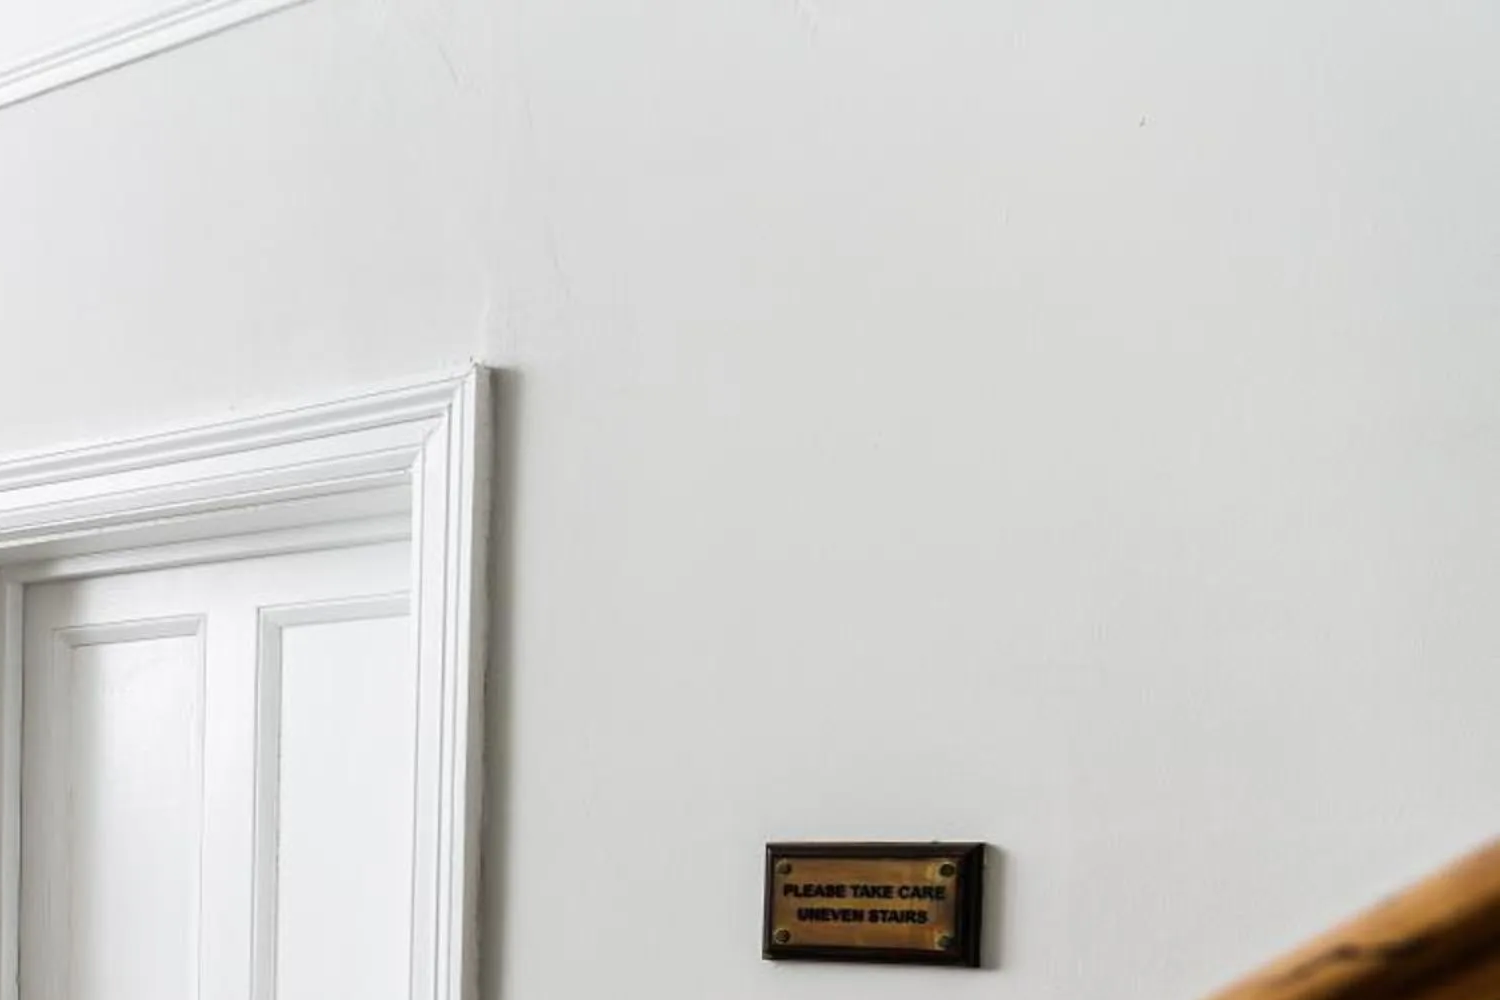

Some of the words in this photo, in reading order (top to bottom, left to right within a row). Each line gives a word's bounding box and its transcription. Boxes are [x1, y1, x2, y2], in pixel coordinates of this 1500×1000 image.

[783, 883, 846, 898] PLEASE
[850, 884, 894, 899] TAKE
[898, 885, 946, 900] CARE
[797, 907, 864, 922] UNEVEN
[868, 908, 928, 924] STAIRS
